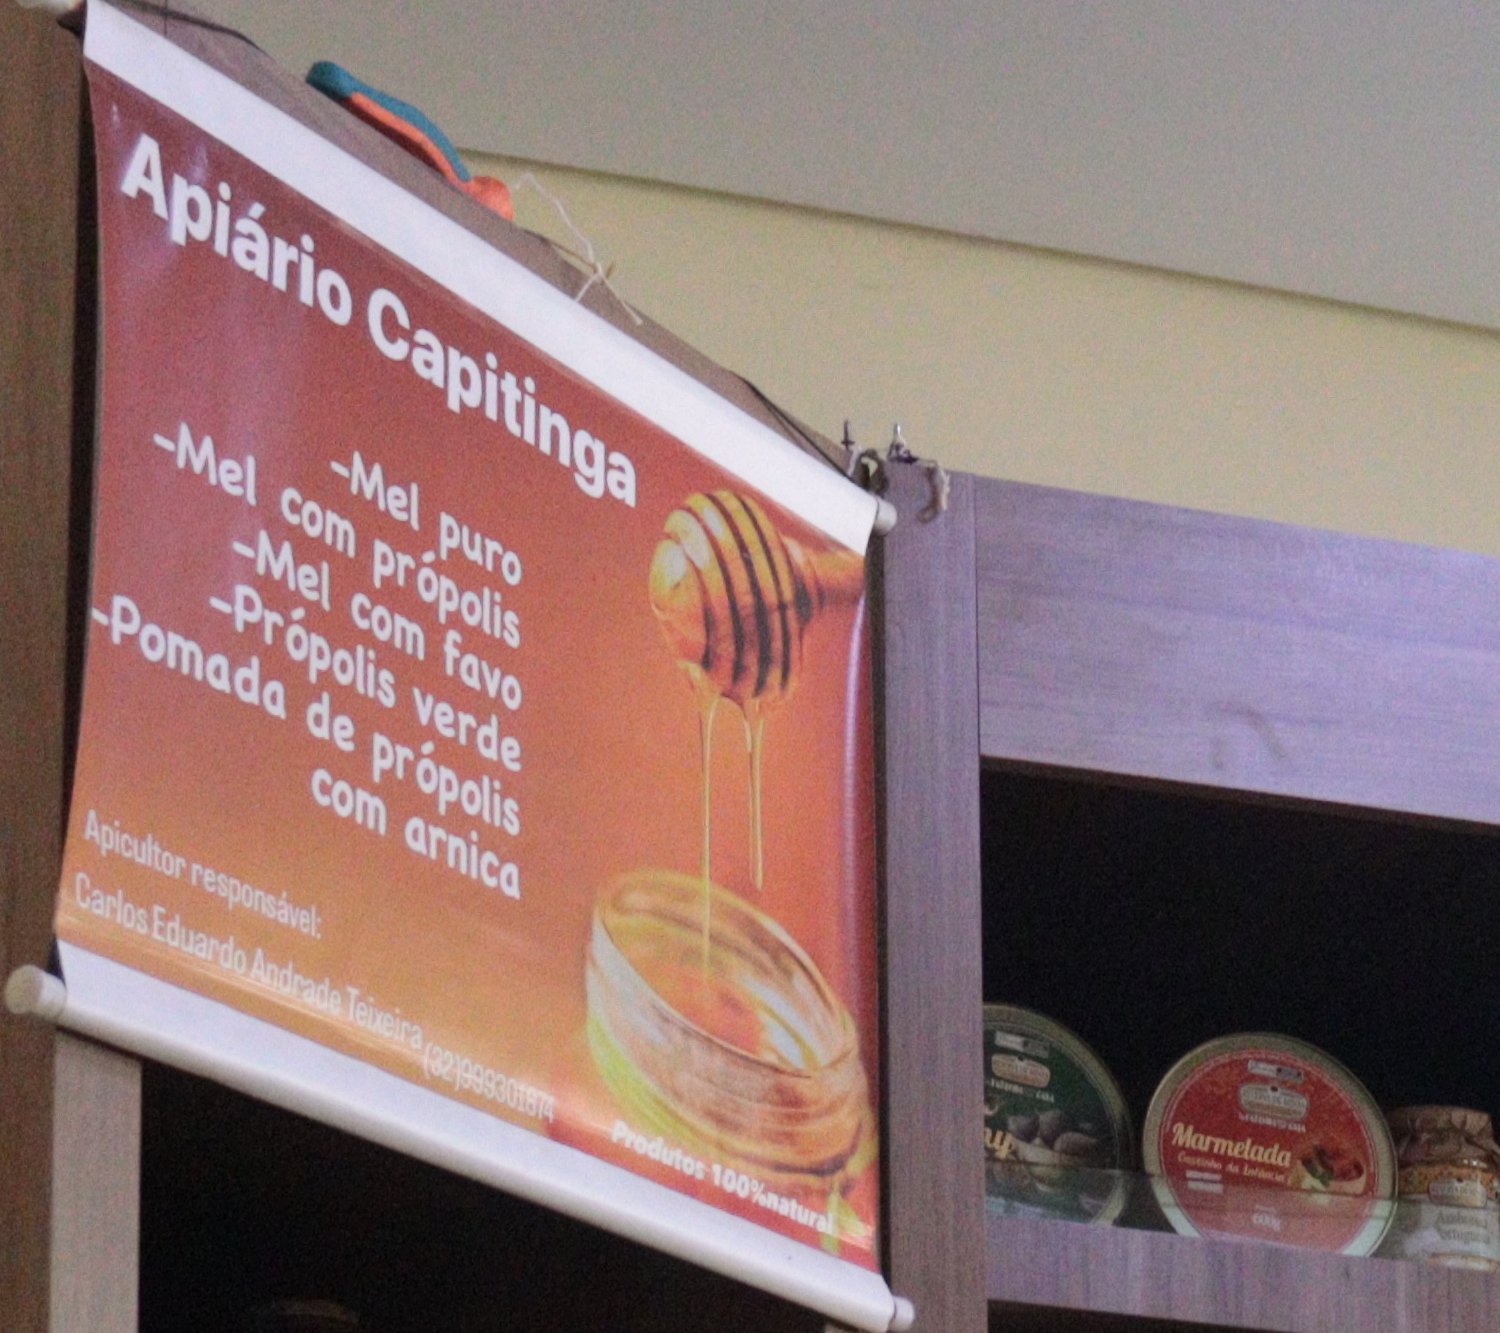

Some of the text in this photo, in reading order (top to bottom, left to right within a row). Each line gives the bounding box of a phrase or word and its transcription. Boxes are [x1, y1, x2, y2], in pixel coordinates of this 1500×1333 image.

[120, 132, 636, 508] Apiário Capitinga
[153, 421, 521, 648] -Mel com própolis
[330, 450, 522, 586] -Mel puro
[209, 585, 521, 771] -Própolis verde
[232, 529, 522, 710] -Mel com favo
[91, 595, 521, 836] -Pomada de própolis
[83, 809, 322, 939] Apicultor responsável:
[310, 768, 521, 900] com arnica
[74, 872, 148, 935] Carlos
[152, 904, 247, 975] Eduardo
[250, 948, 342, 1016] Andrade
[345, 985, 423, 1048] Teixeira
[609, 1118, 706, 1182] Produtos
[1171, 1122, 1292, 1167] Marmelada
